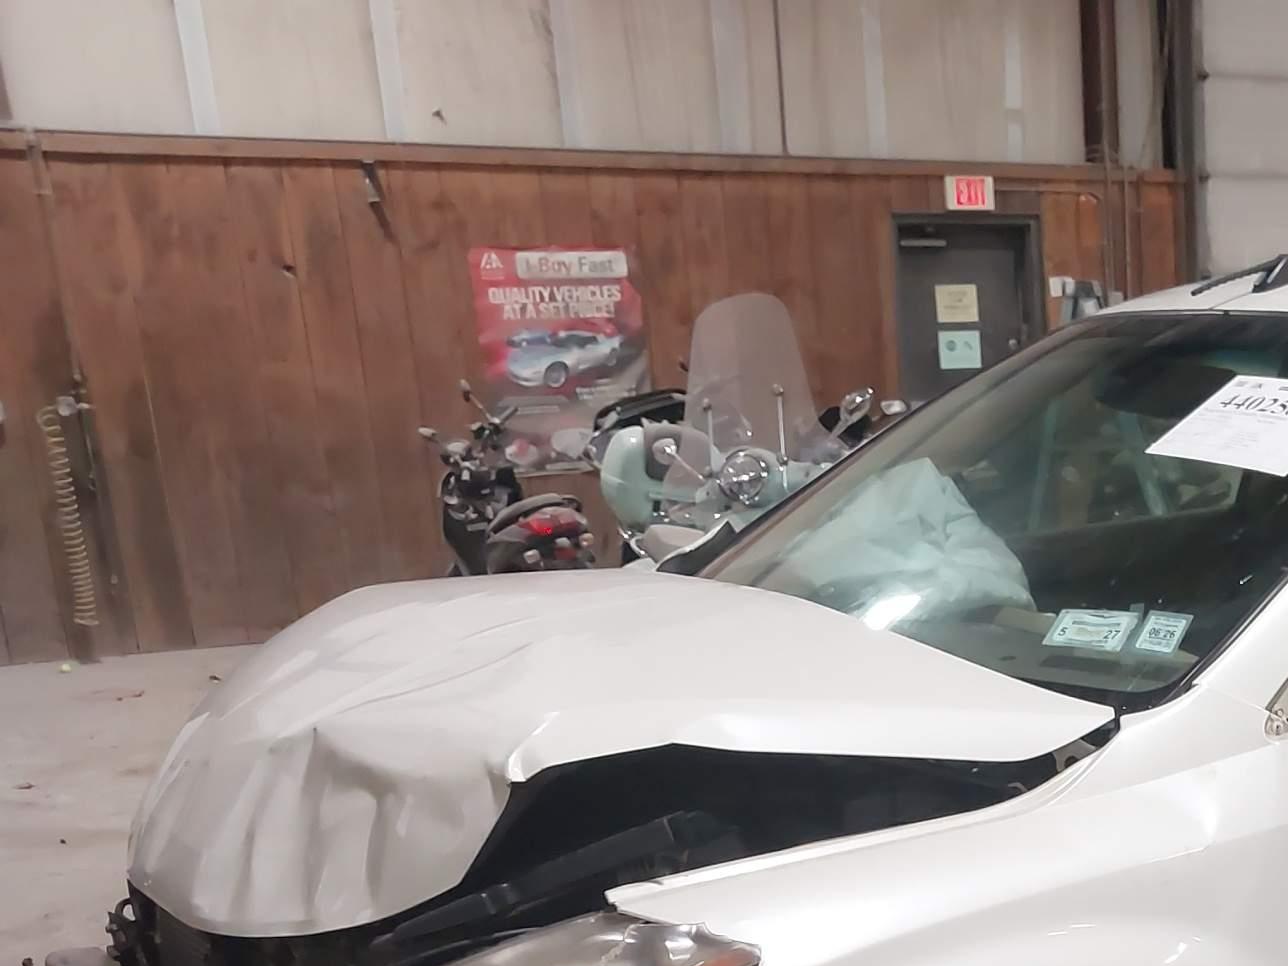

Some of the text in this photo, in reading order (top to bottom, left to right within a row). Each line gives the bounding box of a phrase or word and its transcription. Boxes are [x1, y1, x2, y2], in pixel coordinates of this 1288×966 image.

[578, 256, 615, 273] Fast
[488, 285, 622, 304] QUALITY VEHICLES
[503, 304, 524, 320] AT
[525, 303, 537, 319] A
[539, 302, 567, 319] SET
[1057, 626, 1121, 640] 5 27
